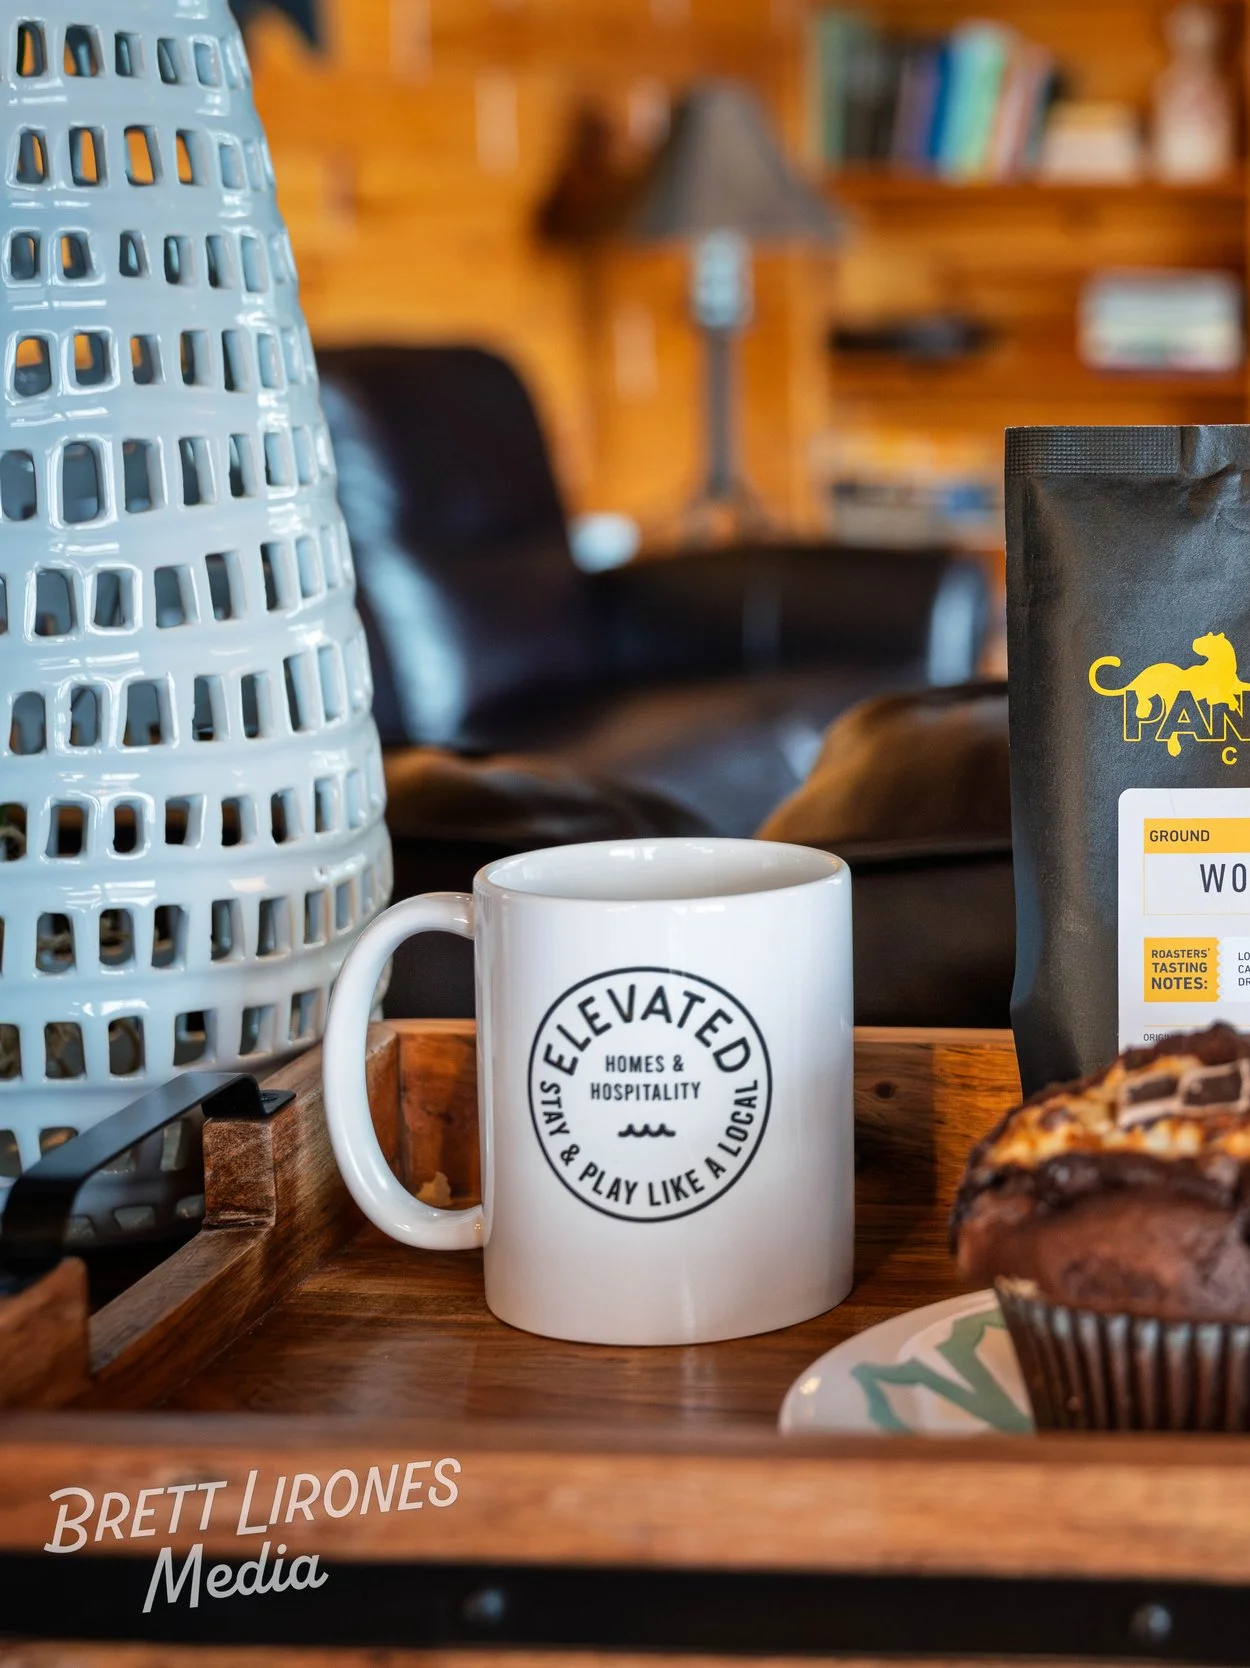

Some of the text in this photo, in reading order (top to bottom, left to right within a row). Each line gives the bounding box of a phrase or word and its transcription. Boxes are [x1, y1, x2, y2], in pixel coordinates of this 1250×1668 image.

[1149, 829, 1211, 843] GROUND
[1151, 961, 1208, 973] TASTING
[1151, 976, 1208, 990] NOTES:
[543, 984, 752, 1076] ELEVATED
[605, 1054, 685, 1073] HOMES &
[590, 1081, 701, 1101] HOSPITALITY
[540, 1079, 759, 1207] STAY & PLAY LIKE A LOCAL
